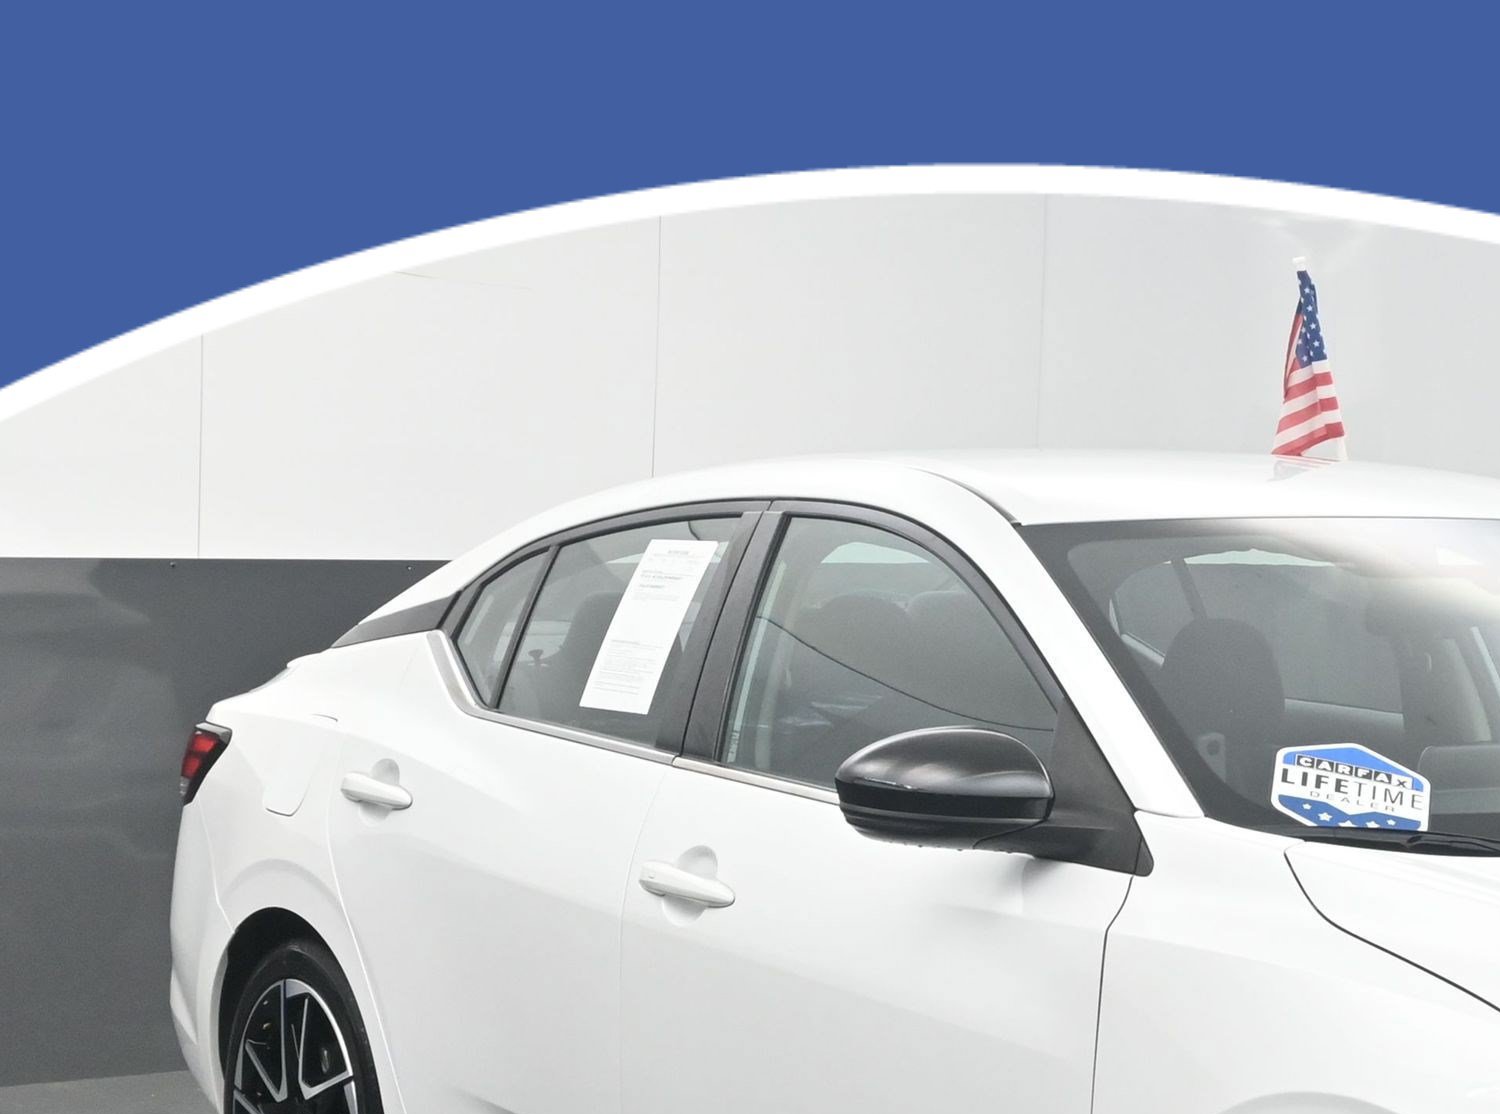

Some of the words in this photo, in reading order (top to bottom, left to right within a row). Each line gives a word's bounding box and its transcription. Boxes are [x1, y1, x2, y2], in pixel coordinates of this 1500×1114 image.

[1280, 767, 1425, 811] LIFETIME
[1297, 755, 1411, 790] CARFAX
[1309, 790, 1396, 813] DEALER
